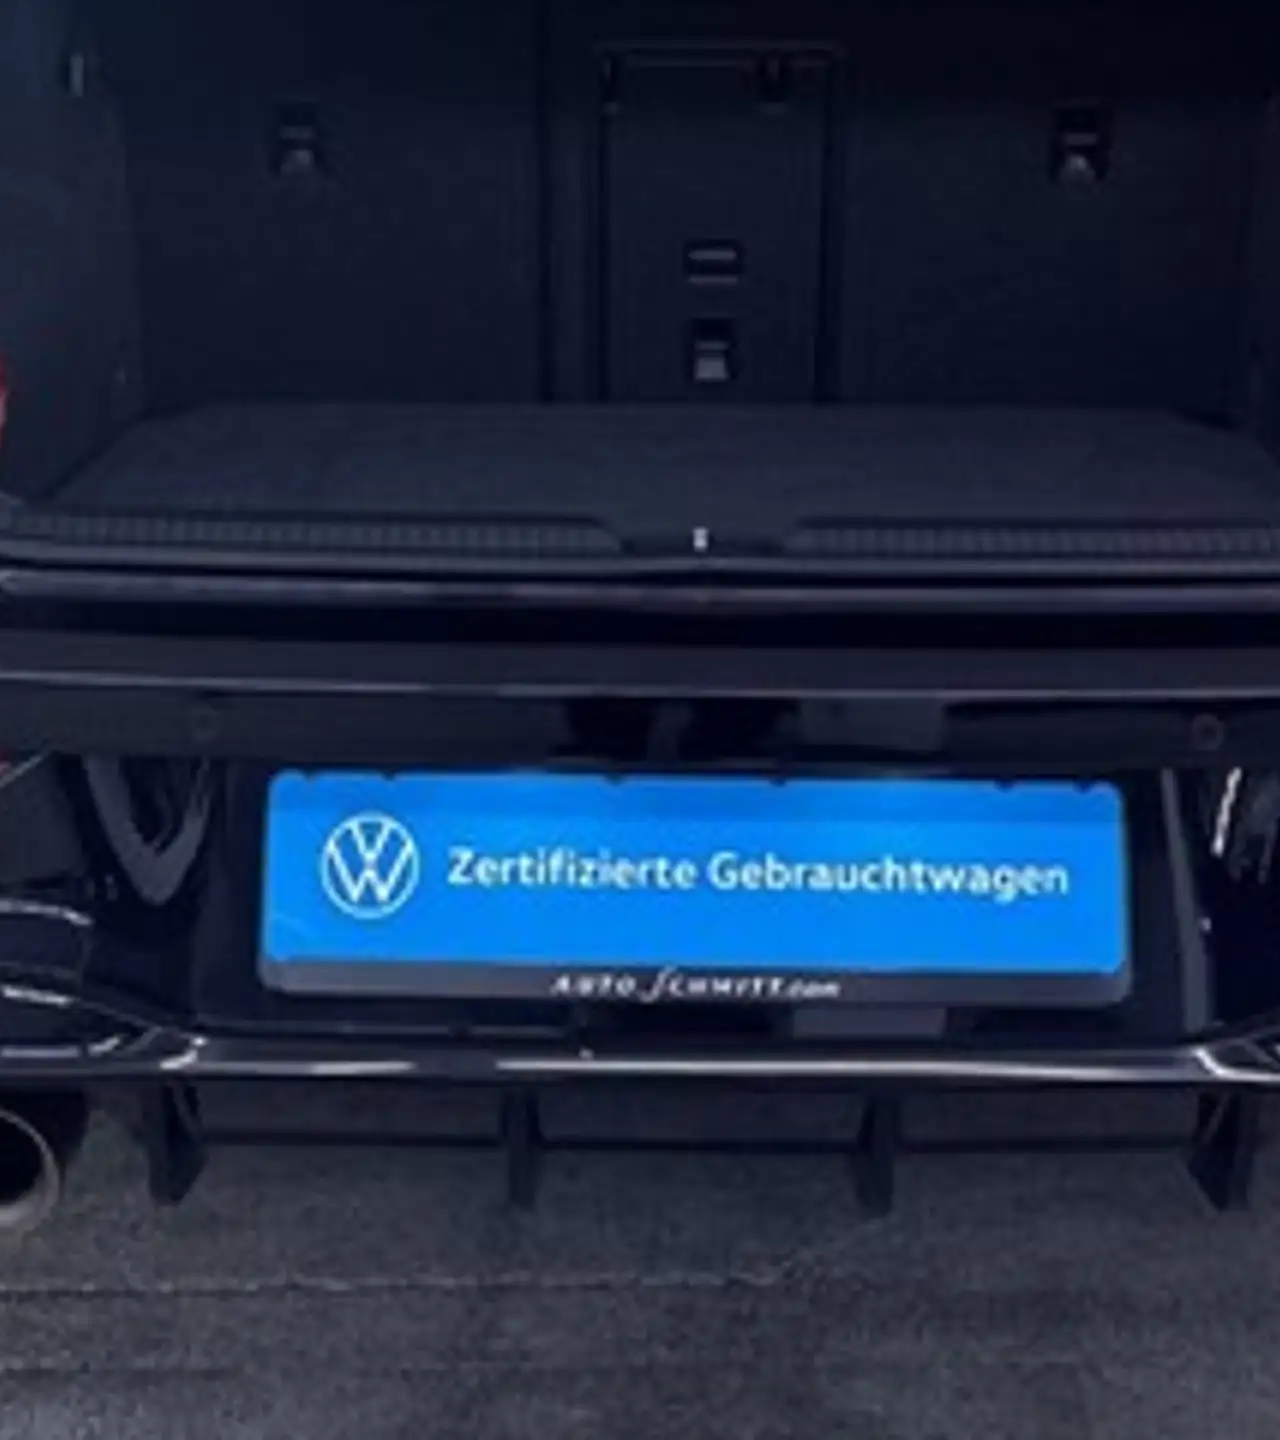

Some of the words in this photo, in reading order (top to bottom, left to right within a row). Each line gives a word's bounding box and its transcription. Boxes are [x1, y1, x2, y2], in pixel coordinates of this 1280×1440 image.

[446, 845, 699, 889] Zertifizierte
[707, 851, 1070, 904] Gebrauchtwagen
[549, 972, 637, 998] AUTO
